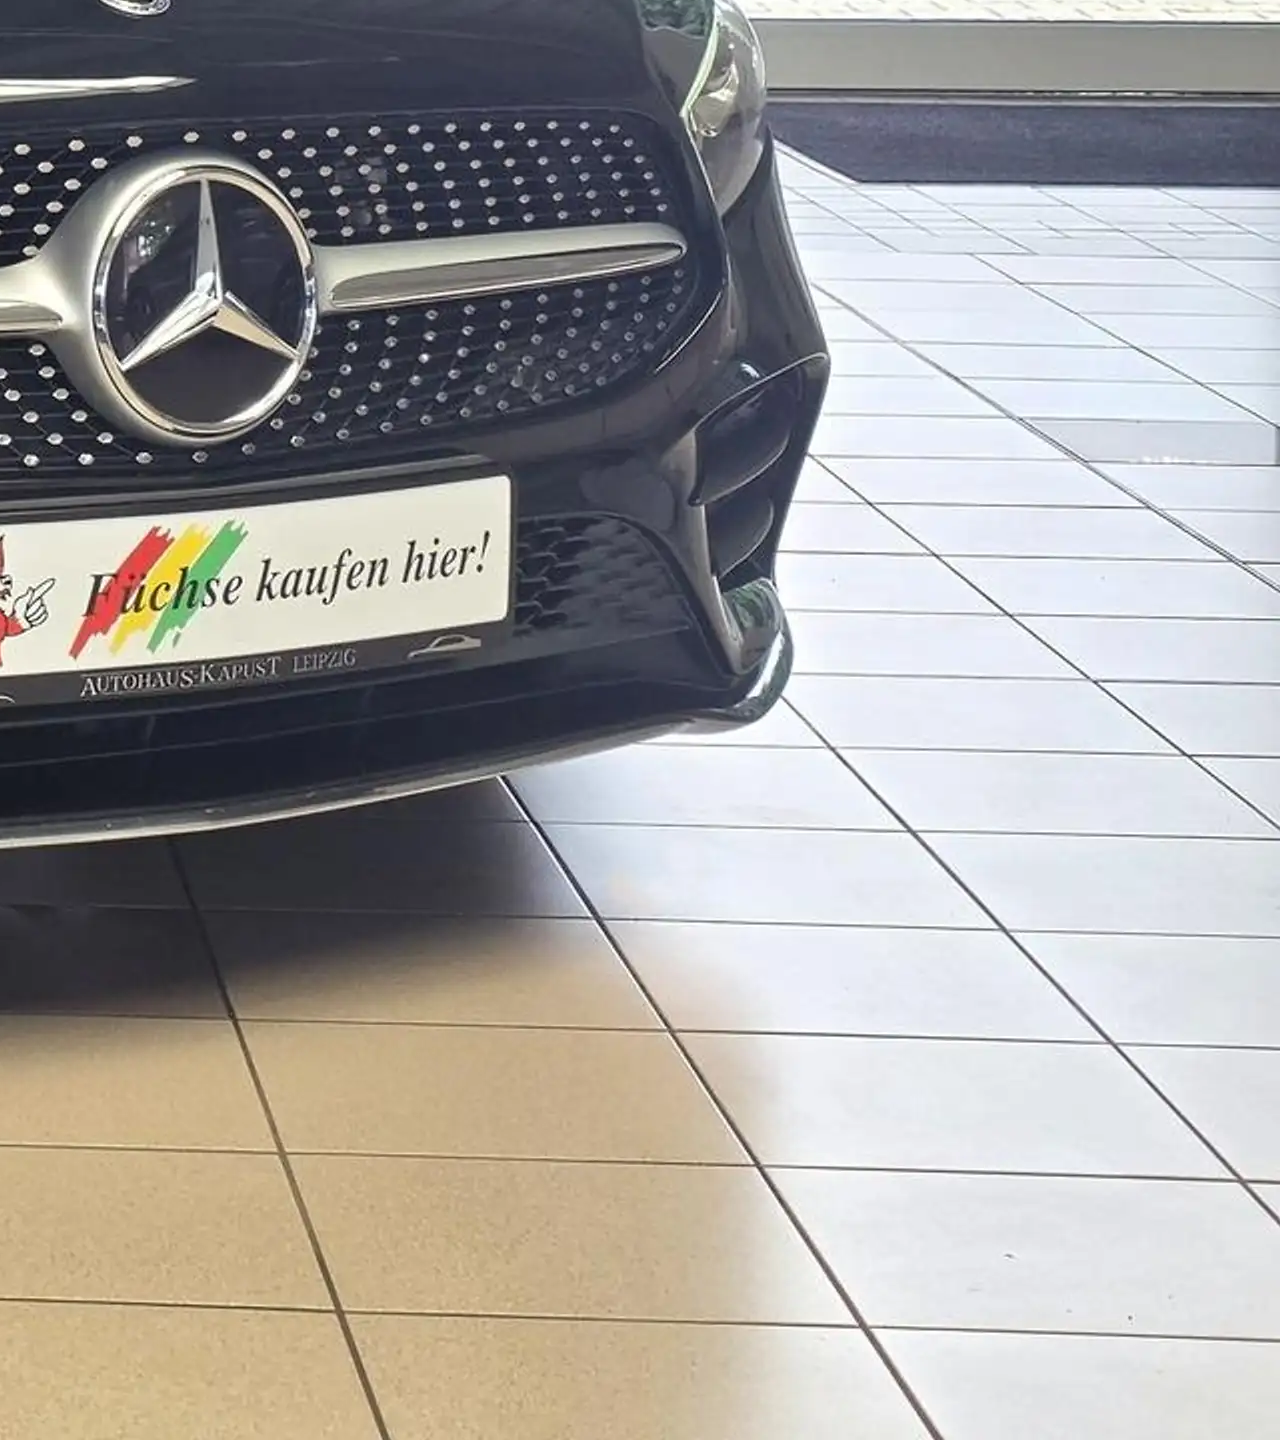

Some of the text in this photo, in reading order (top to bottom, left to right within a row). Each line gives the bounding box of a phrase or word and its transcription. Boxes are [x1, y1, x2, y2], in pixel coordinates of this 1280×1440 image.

[82, 530, 491, 618] Füchse kaufen hier!
[293, 649, 357, 674] LEIPZIG
